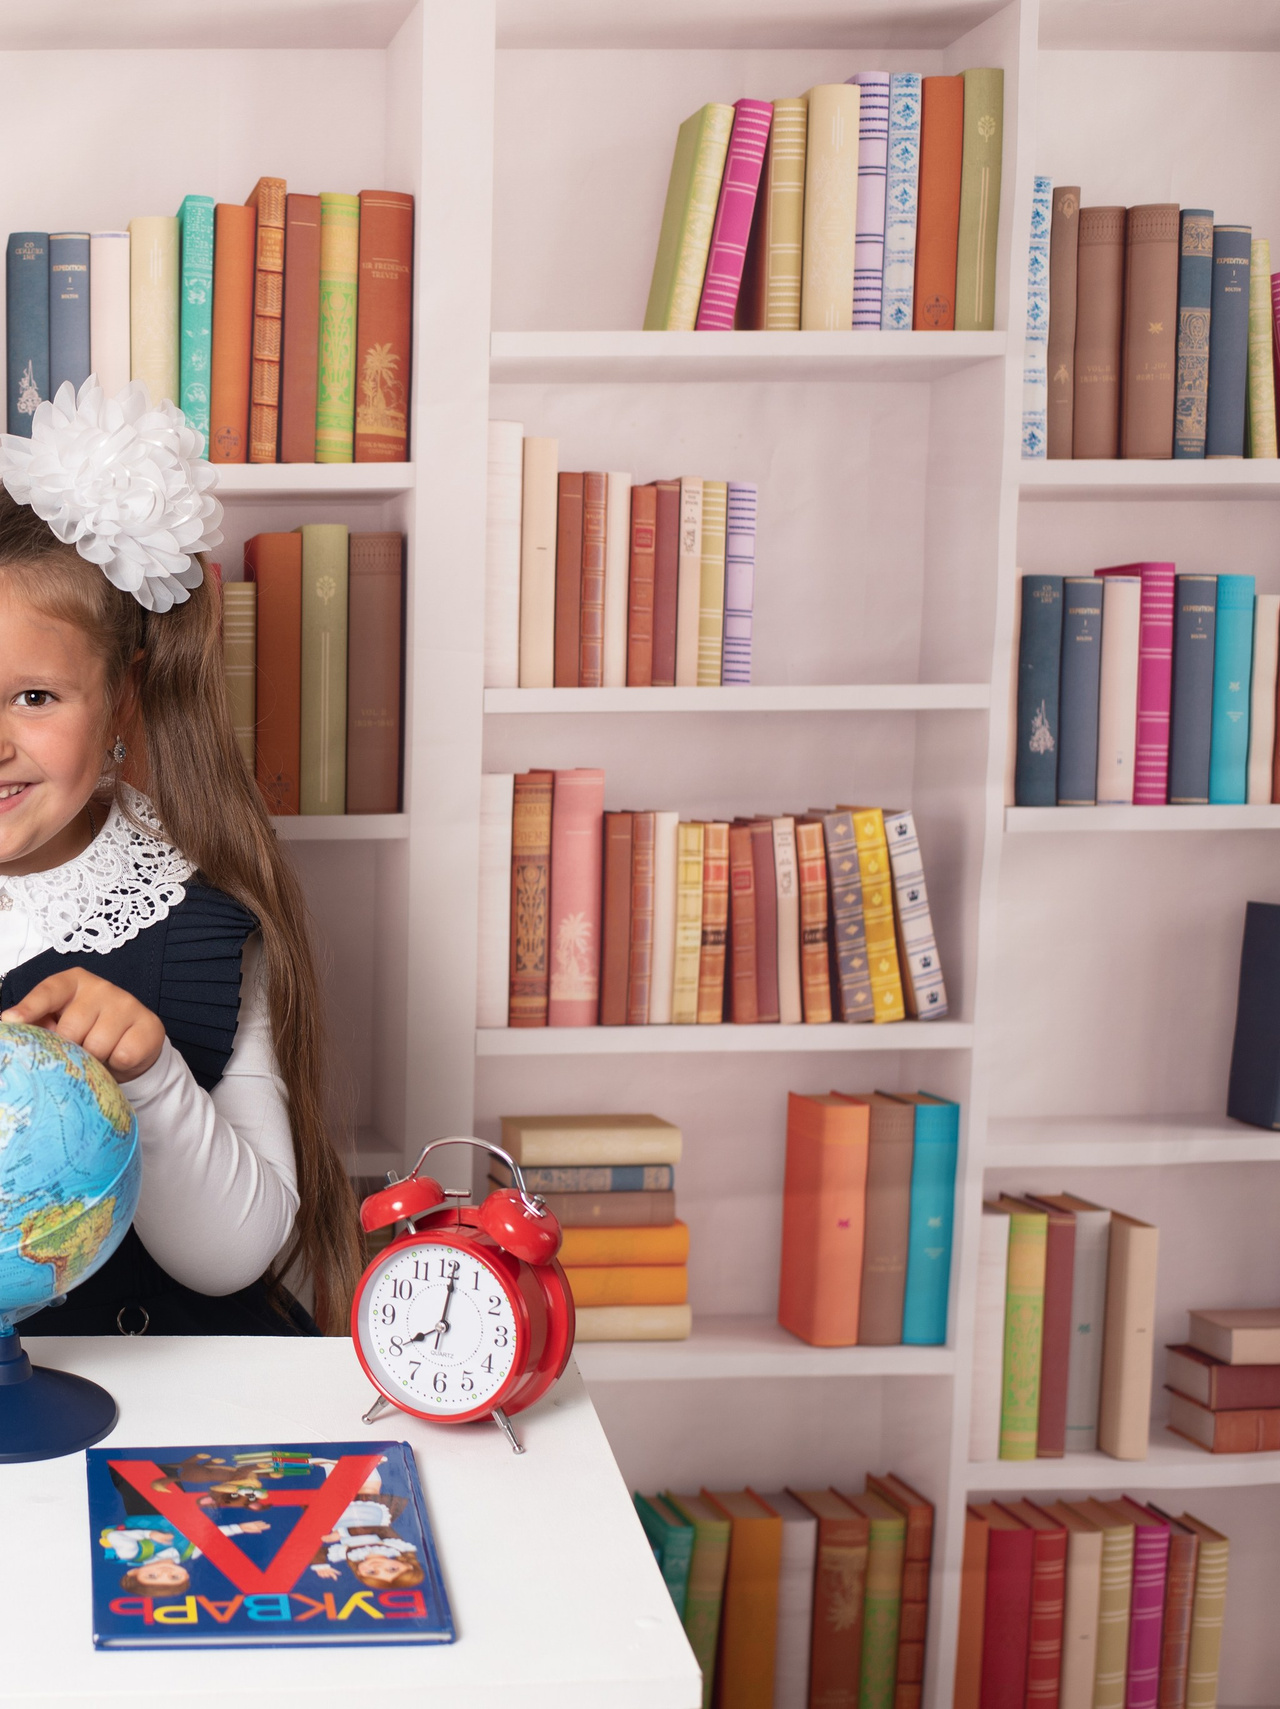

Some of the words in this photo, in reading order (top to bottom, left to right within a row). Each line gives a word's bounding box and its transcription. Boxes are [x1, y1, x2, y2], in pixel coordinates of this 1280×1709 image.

[412, 1259, 430, 1282] 11
[439, 1258, 461, 1281] 12
[472, 1270, 481, 1291] 1
[390, 1278, 413, 1301] 10
[381, 1303, 396, 1326] 9
[488, 1295, 502, 1316] 2
[388, 1335, 404, 1357] 8
[494, 1325, 508, 1348] 3
[430, 1350, 455, 1360] QUARTZ
[481, 1353, 495, 1374] 4
[408, 1360, 422, 1381] 7
[460, 1371, 475, 1392] 5
[433, 1371, 448, 1394] 6
[108, 1590, 429, 1626] БУКВАРЬ
